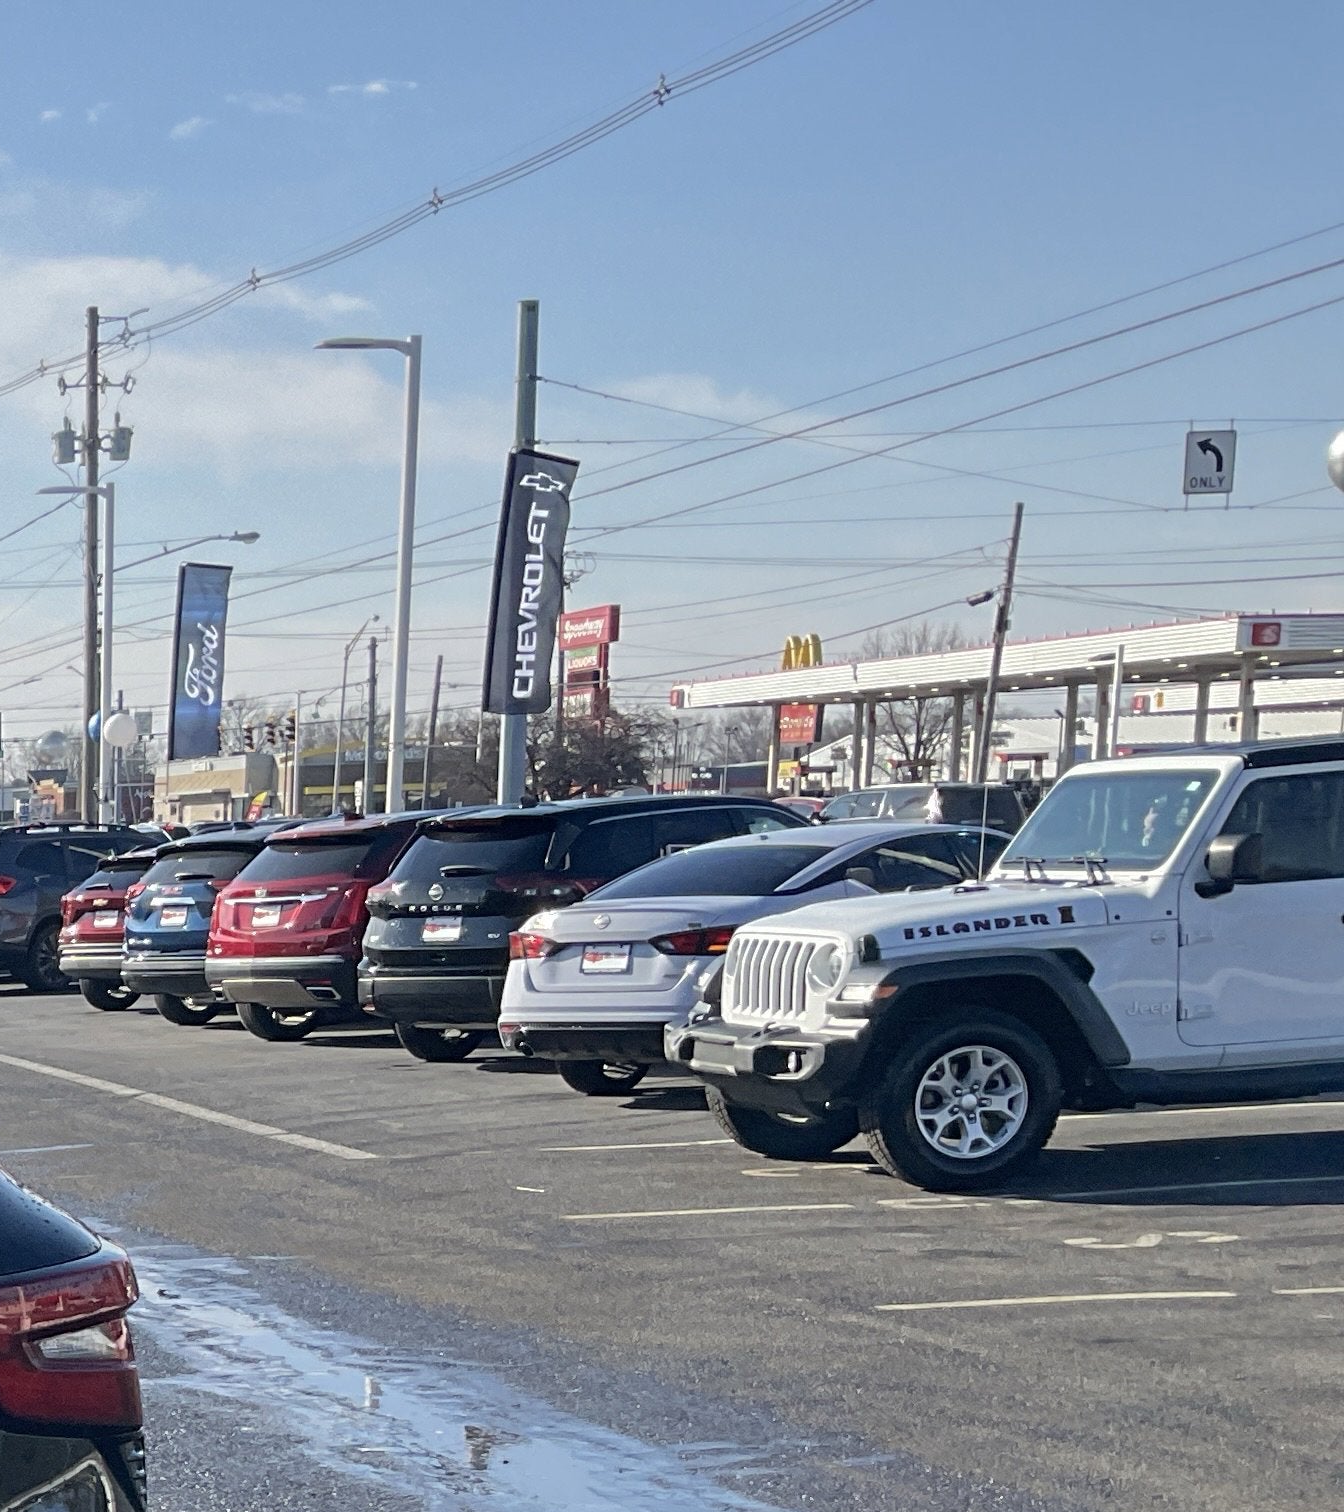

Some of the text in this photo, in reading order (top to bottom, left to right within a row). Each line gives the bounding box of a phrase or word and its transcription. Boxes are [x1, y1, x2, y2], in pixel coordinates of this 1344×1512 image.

[1190, 476, 1226, 489] ONLY
[512, 501, 550, 699] CHEVROLET
[184, 622, 219, 706] Ford
[904, 913, 1050, 940] ISLANDER
